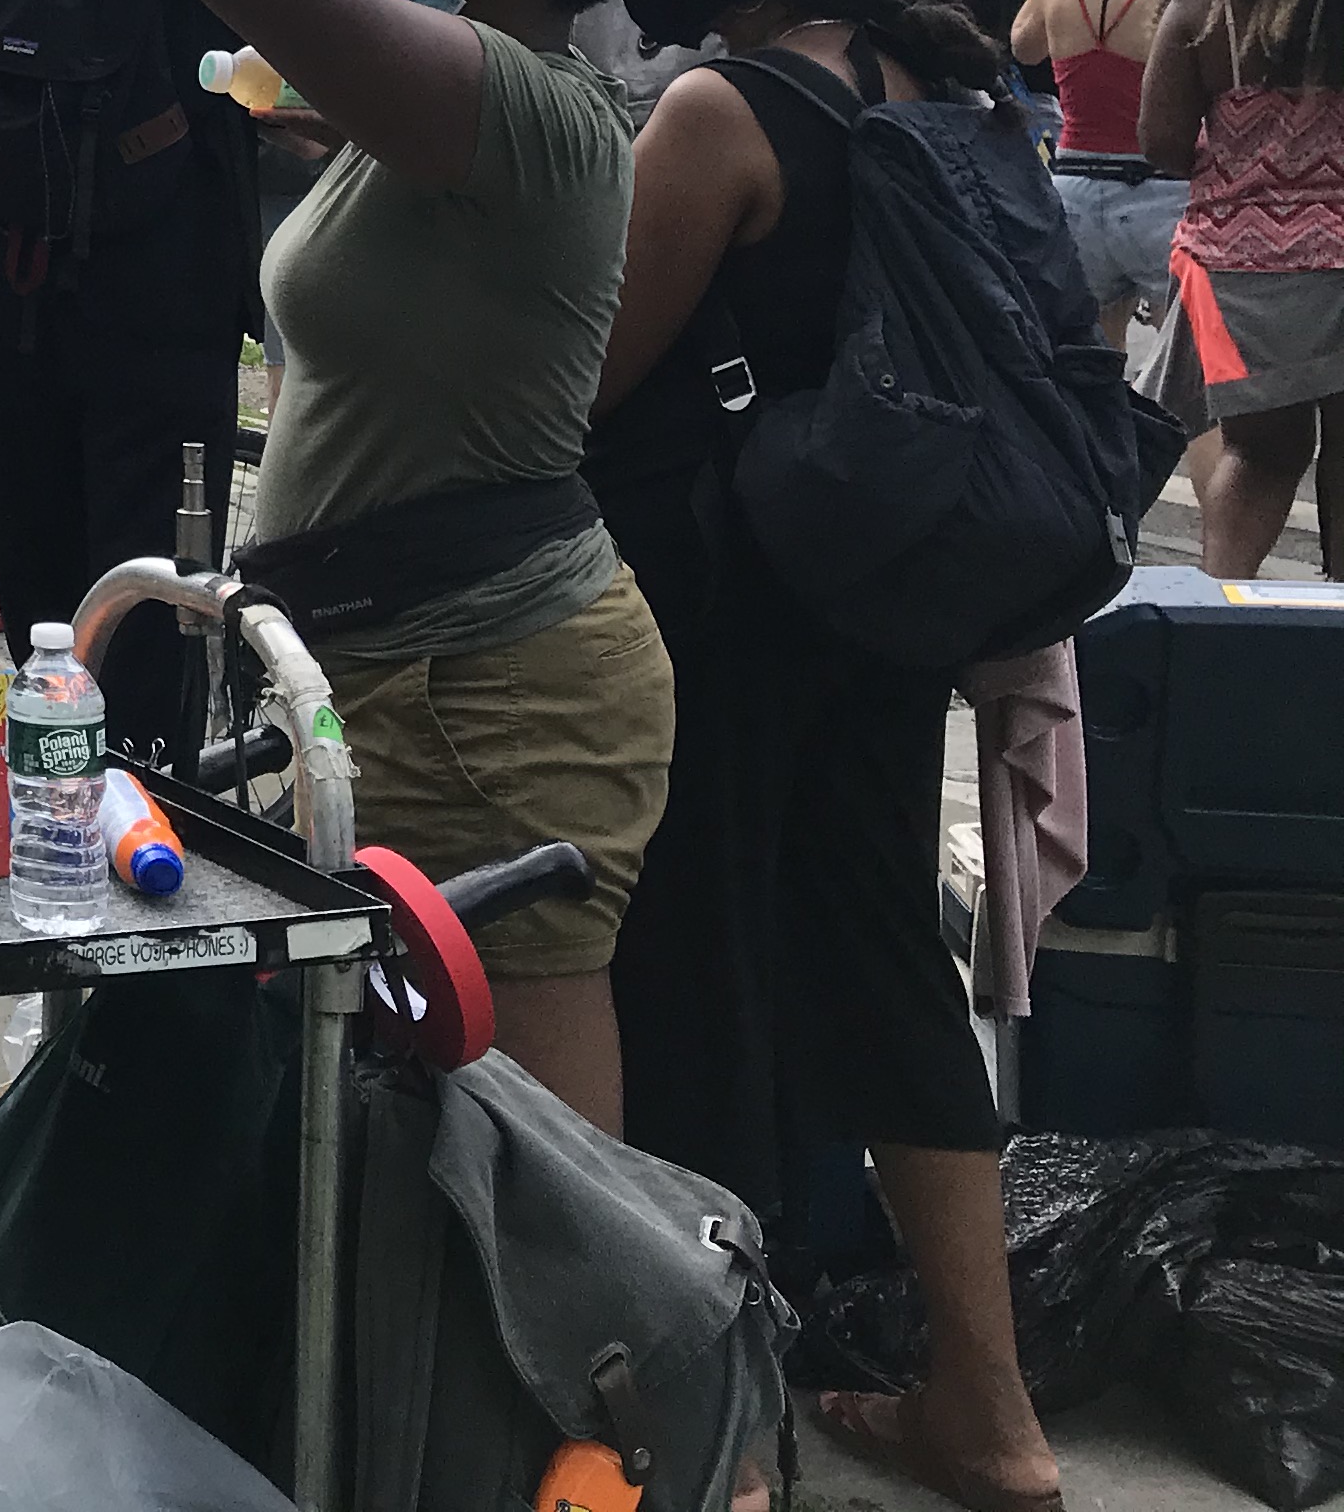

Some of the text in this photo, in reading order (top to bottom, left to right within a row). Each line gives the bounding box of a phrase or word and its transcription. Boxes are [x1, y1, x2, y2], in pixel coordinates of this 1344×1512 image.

[323, 597, 373, 617] NATHAN
[39, 729, 88, 754] Poland
[41, 746, 91, 769] Spring
[71, 945, 126, 966] HARGE
